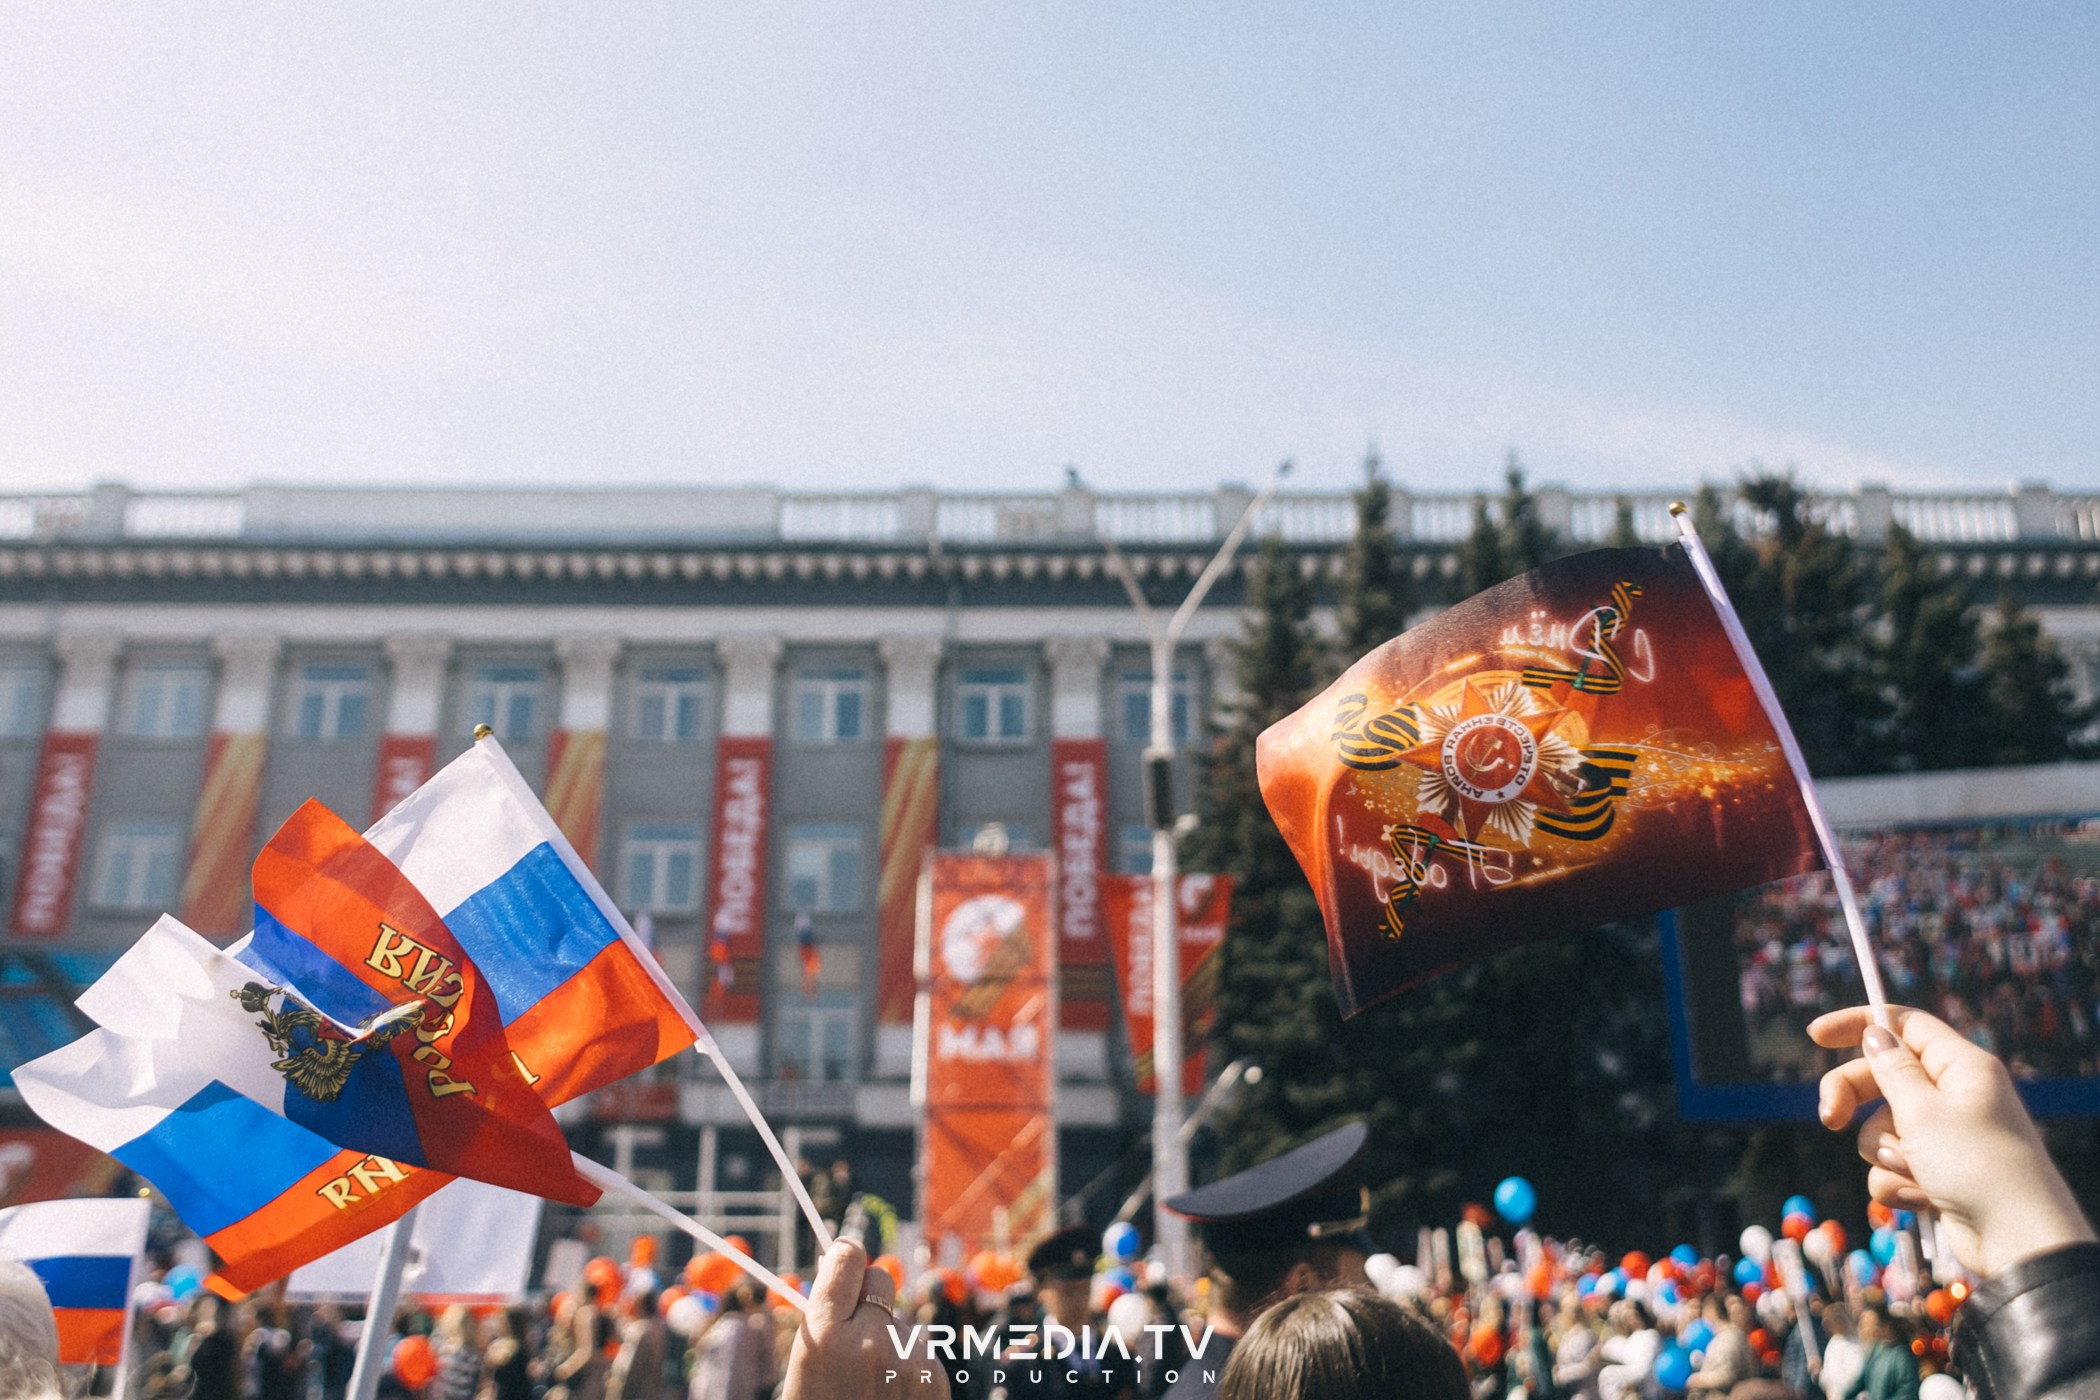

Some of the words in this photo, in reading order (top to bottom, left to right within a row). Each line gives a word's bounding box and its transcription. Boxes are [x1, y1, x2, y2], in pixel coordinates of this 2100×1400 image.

[715, 758, 762, 934] ПОБЕДА!
[1062, 762, 1098, 938] ПОБЕДА!
[364, 921, 477, 1097] РОССИЯ
